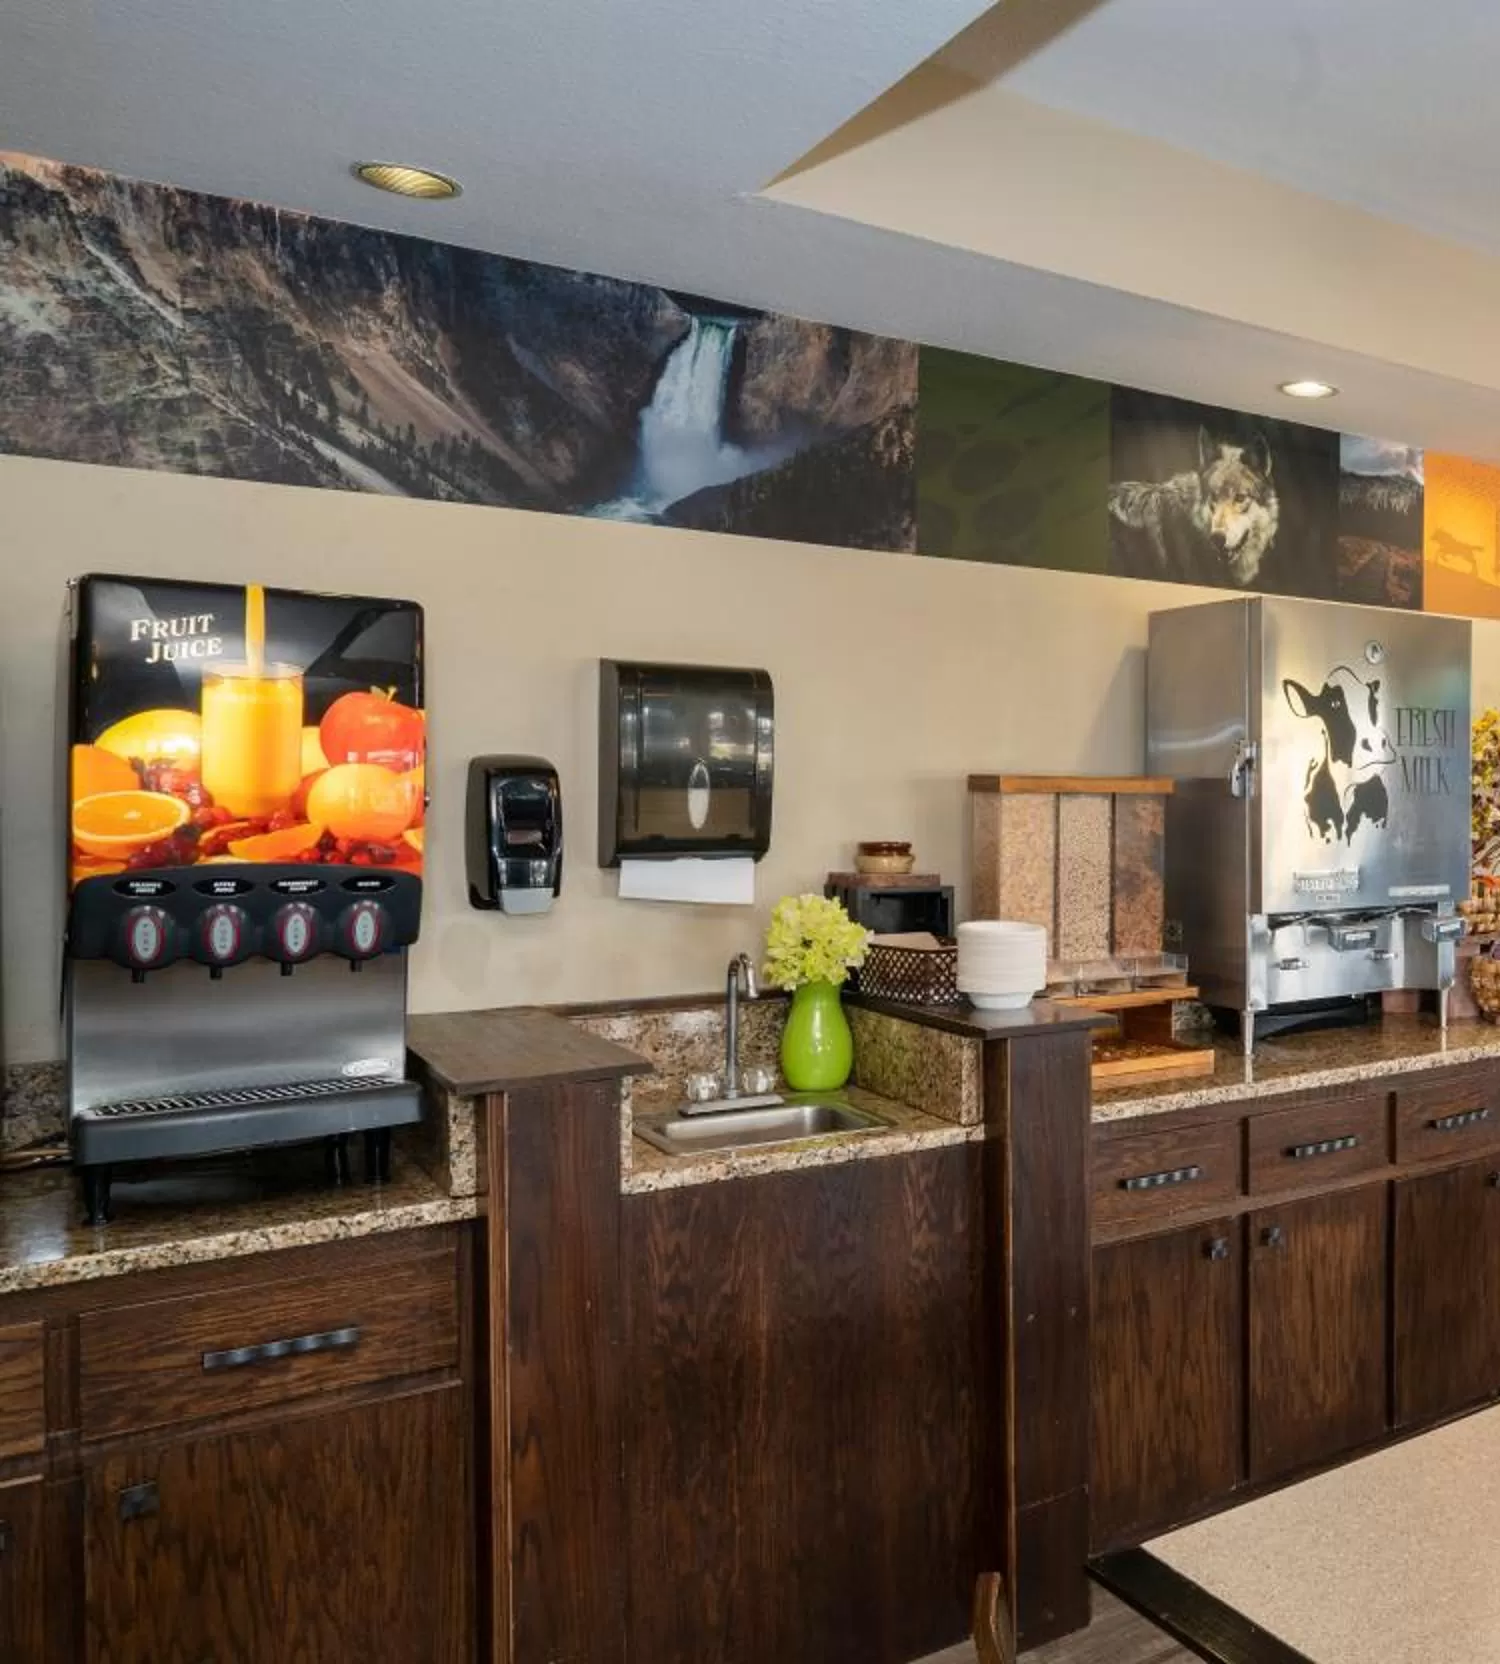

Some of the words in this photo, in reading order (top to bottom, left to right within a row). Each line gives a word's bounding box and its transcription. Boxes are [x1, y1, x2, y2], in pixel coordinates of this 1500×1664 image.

[130, 613, 215, 642] FRUIT
[145, 637, 223, 664] JUICE
[1392, 706, 1456, 749] FRESH
[1401, 755, 1450, 796] MILK
